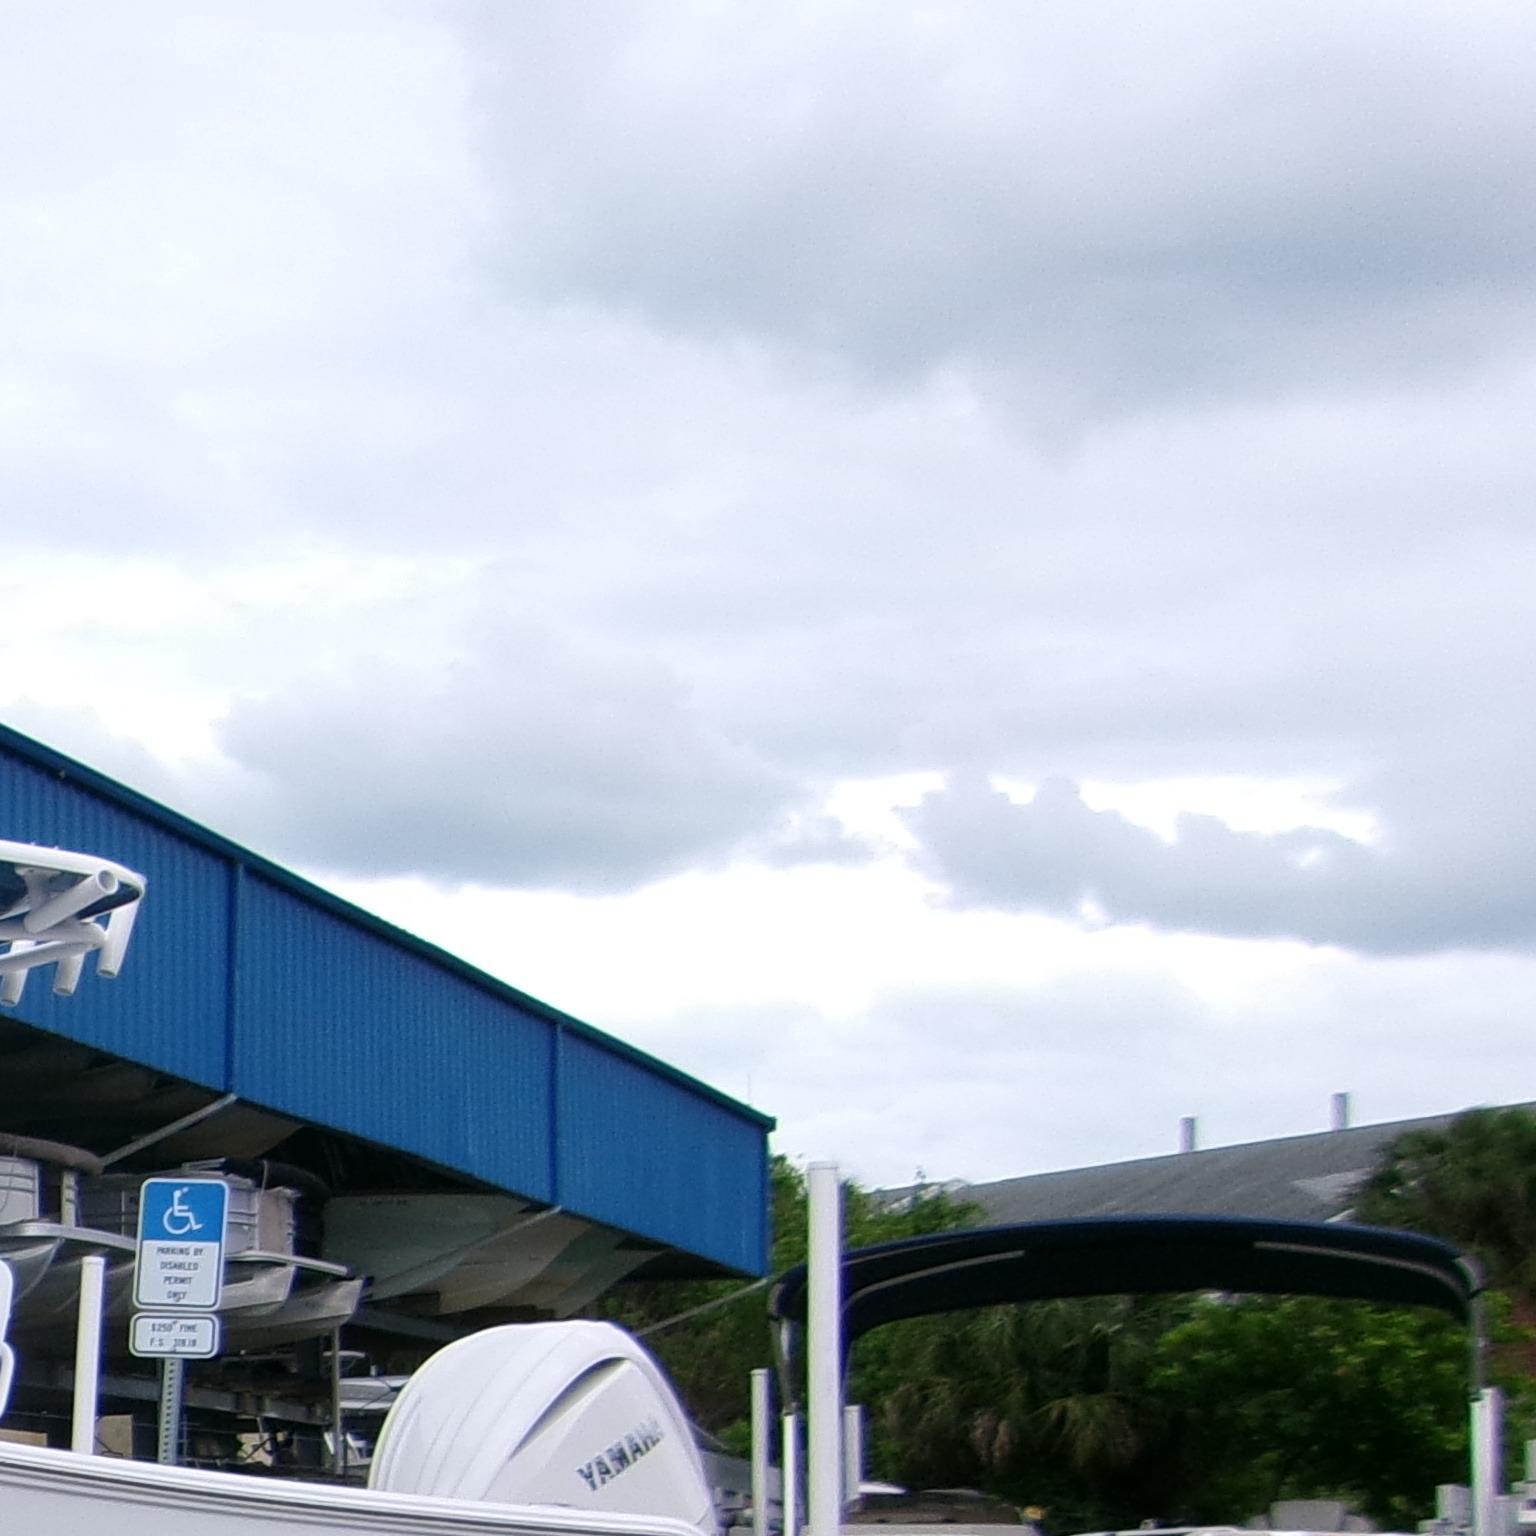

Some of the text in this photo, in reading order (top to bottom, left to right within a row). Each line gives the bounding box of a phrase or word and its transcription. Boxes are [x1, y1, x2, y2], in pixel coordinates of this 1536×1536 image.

[193, 1247, 204, 1257] BY
[160, 1261, 199, 1271] DISABLED
[163, 1276, 192, 1285] PERMIT
